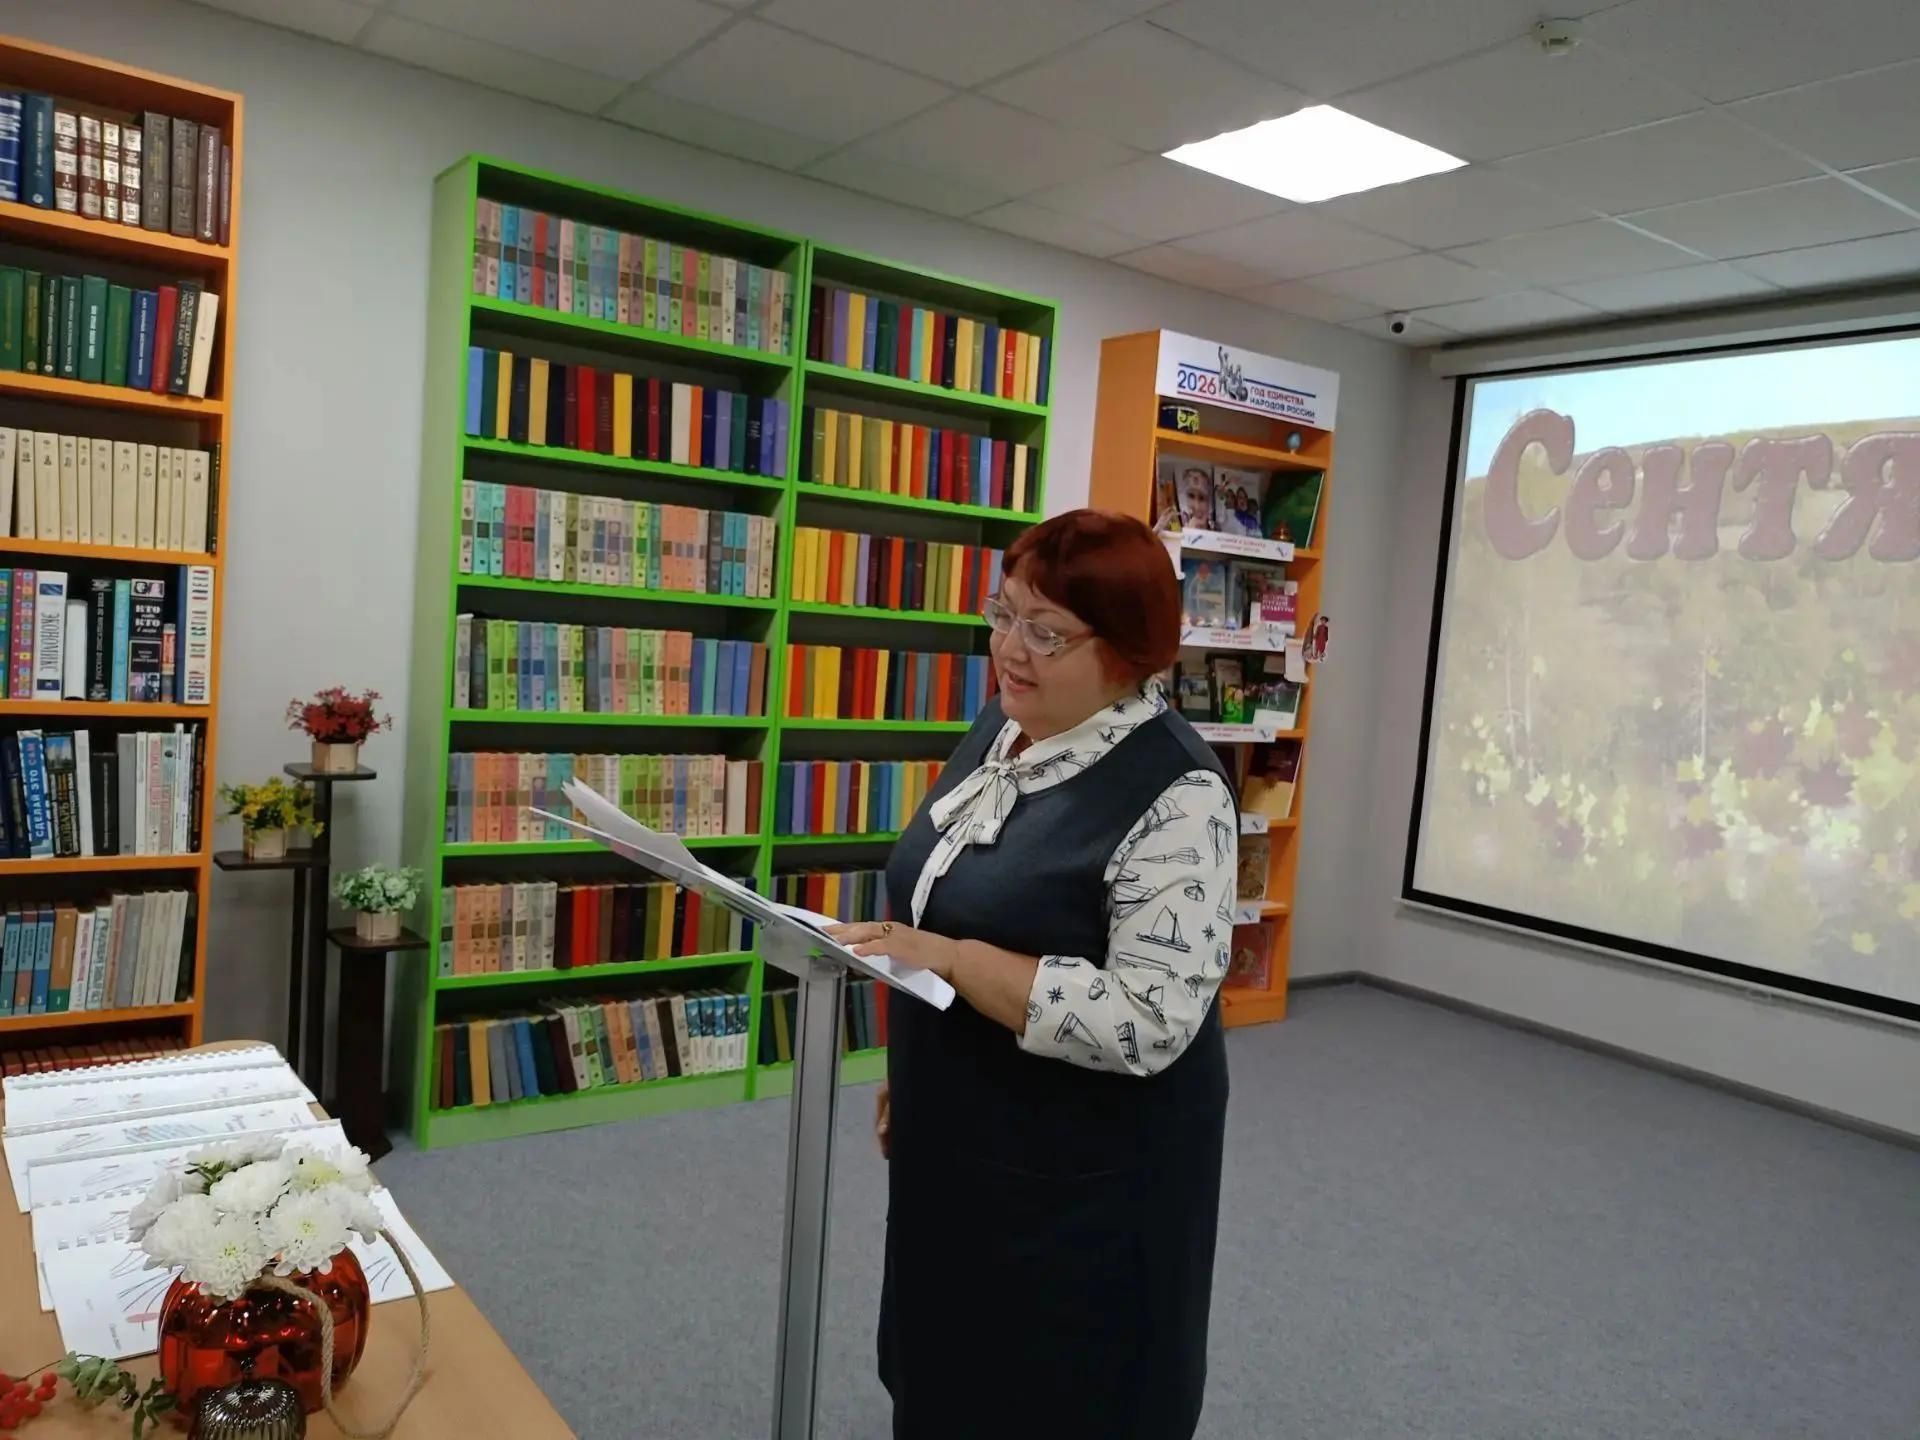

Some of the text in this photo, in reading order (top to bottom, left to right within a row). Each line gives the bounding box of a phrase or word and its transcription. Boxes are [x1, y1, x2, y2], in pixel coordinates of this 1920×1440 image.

[1177, 370, 1216, 395] 2026
[1250, 386, 1305, 406] ГОД ЕДИНСТВА
[1250, 398, 1316, 418] НАРОДОВ РОССИИ
[136, 604, 161, 614] КТО
[135, 618, 161, 627] КТО
[40, 612, 60, 673] ЭКОНОМИКС
[26, 742, 46, 838] СДЕЛАЙ ЭТО САМ
